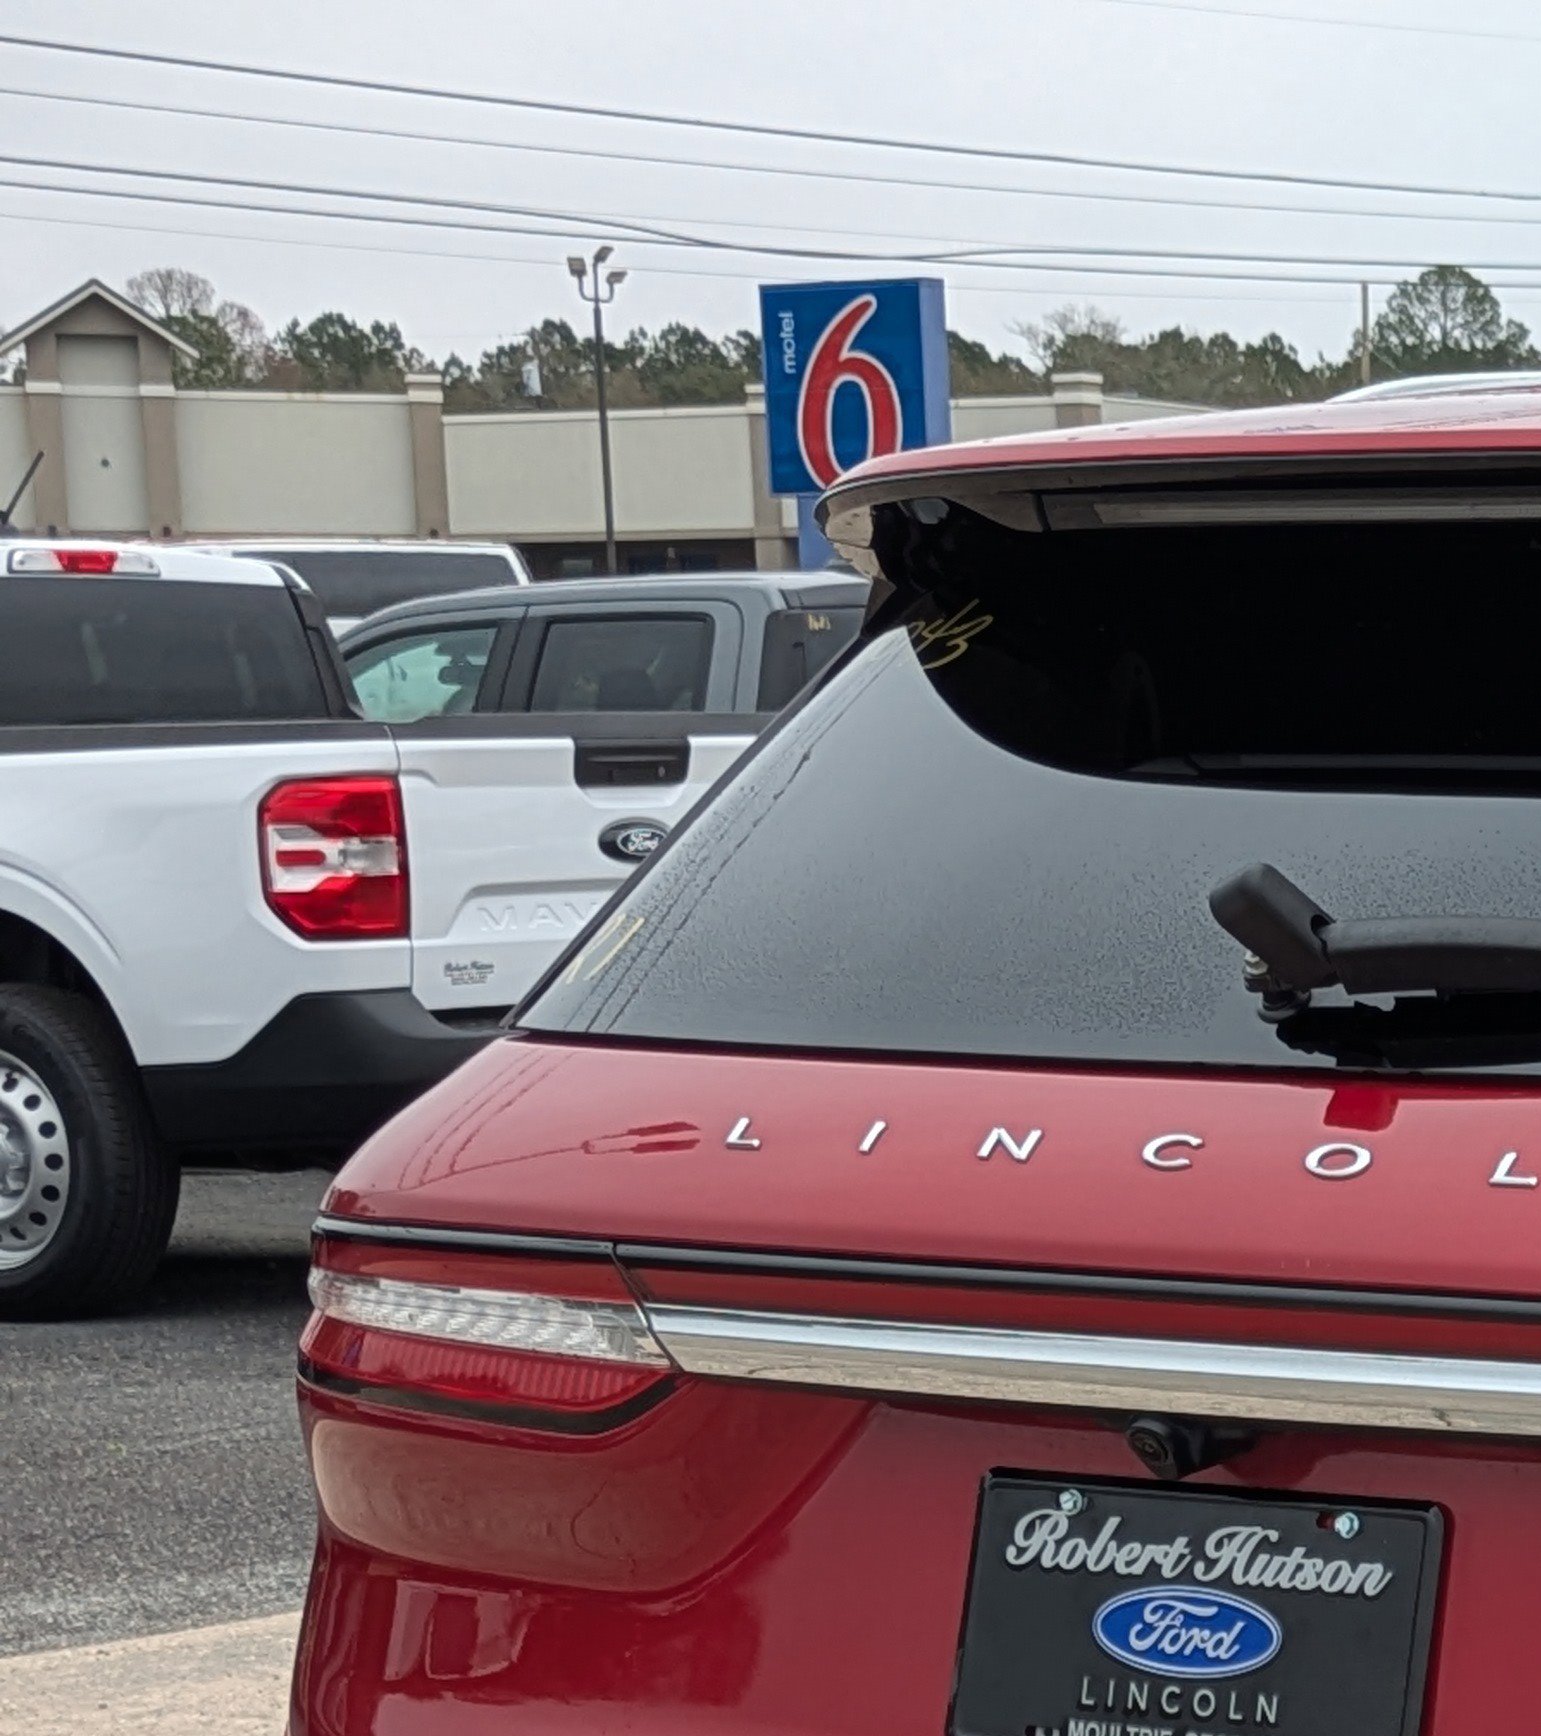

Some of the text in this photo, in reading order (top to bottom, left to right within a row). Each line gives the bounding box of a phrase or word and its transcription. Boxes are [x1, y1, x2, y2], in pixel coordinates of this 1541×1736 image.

[777, 309, 798, 375] motel
[796, 293, 904, 491] 6
[1005, 1508, 1393, 1597] Robert Hutson
[1128, 1599, 1247, 1660] Ford
[1080, 1675, 1279, 1724] LINCOLN
